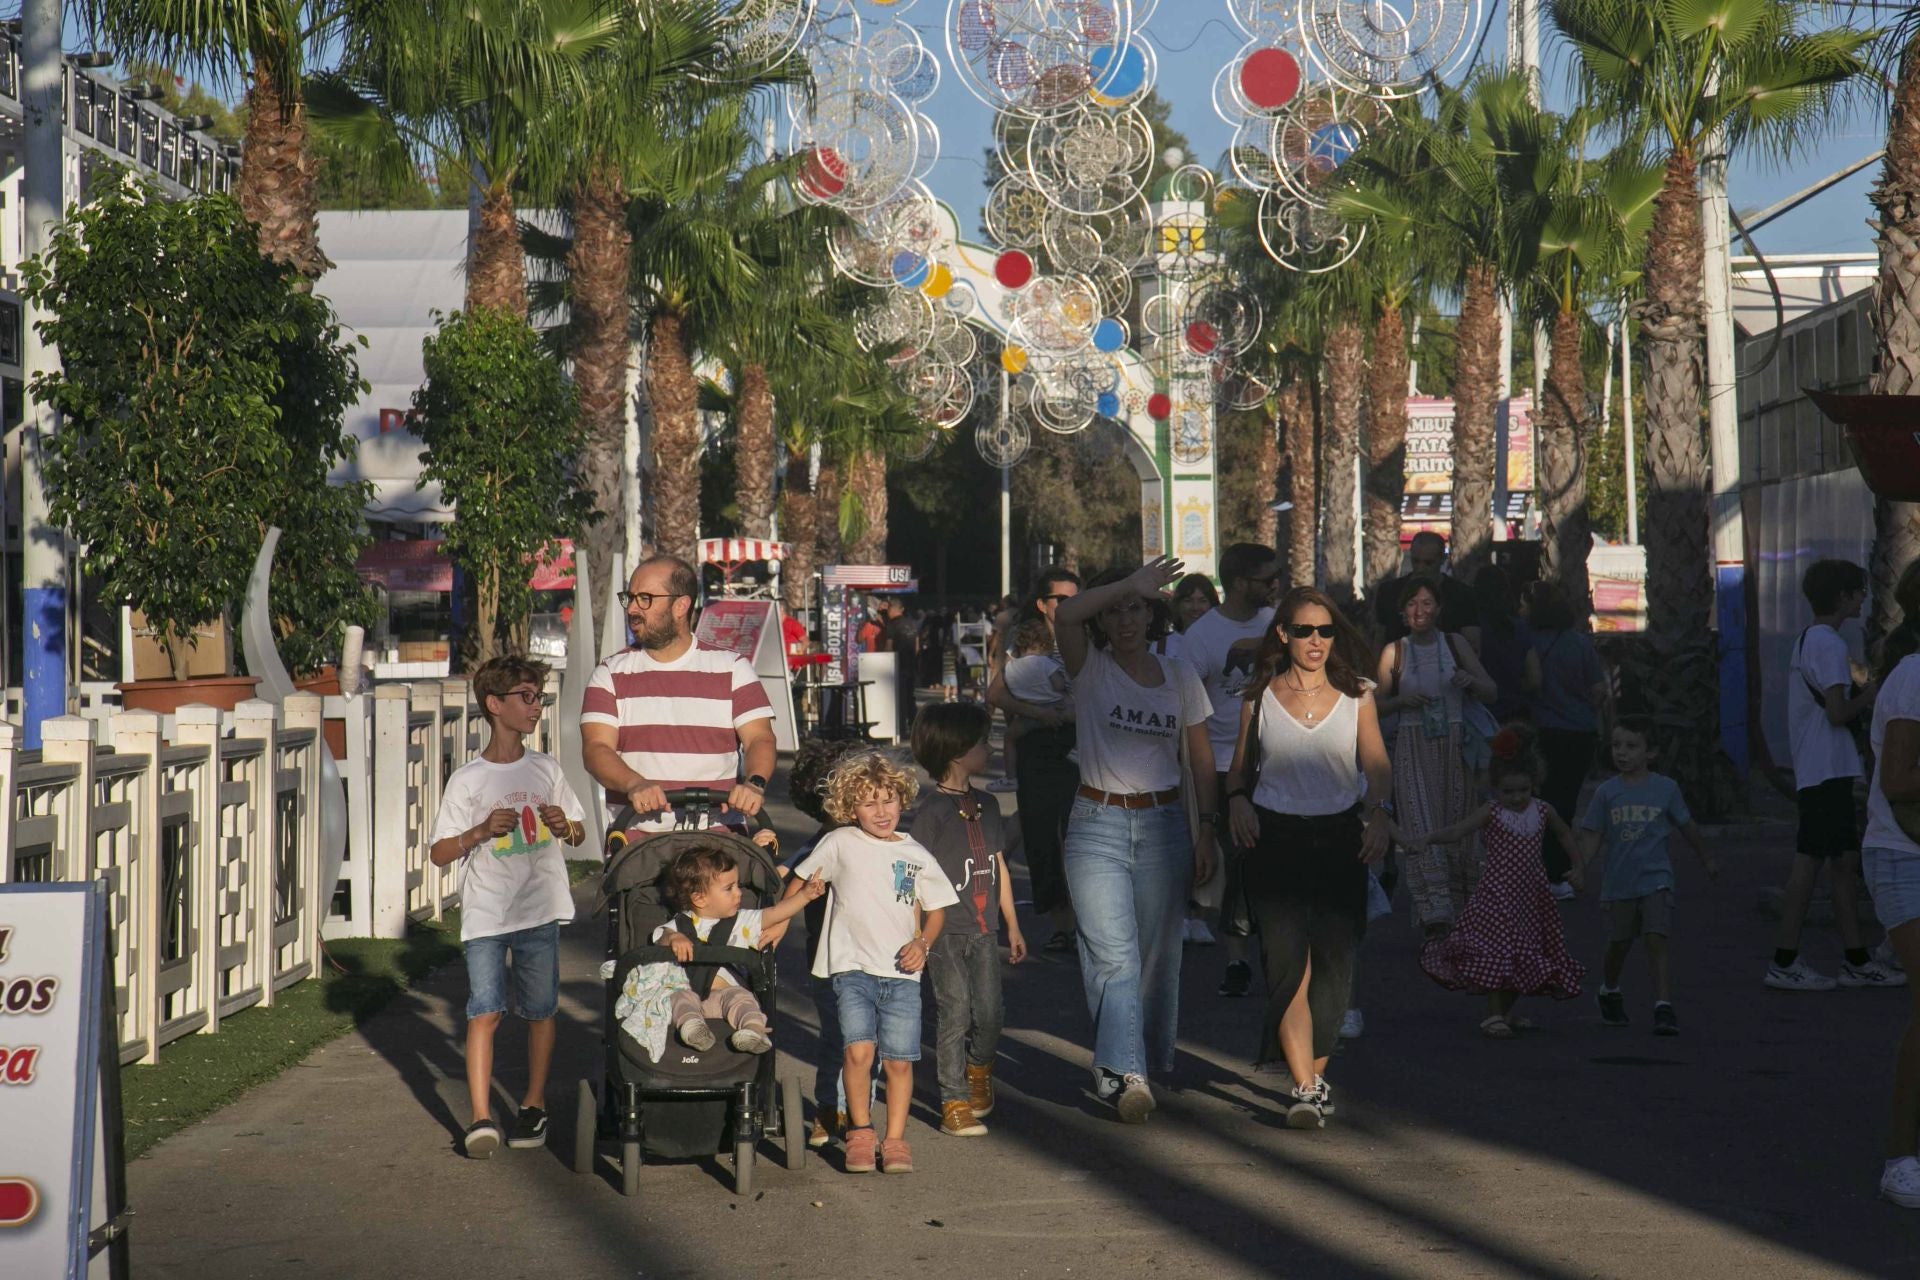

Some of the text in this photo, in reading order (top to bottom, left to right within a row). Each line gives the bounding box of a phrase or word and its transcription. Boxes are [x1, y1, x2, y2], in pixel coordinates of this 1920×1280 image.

[827, 611, 841, 656] BOXER
[1109, 704, 1177, 730] AMAR
[1109, 721, 1122, 729] no
[504, 791, 527, 805] THE
